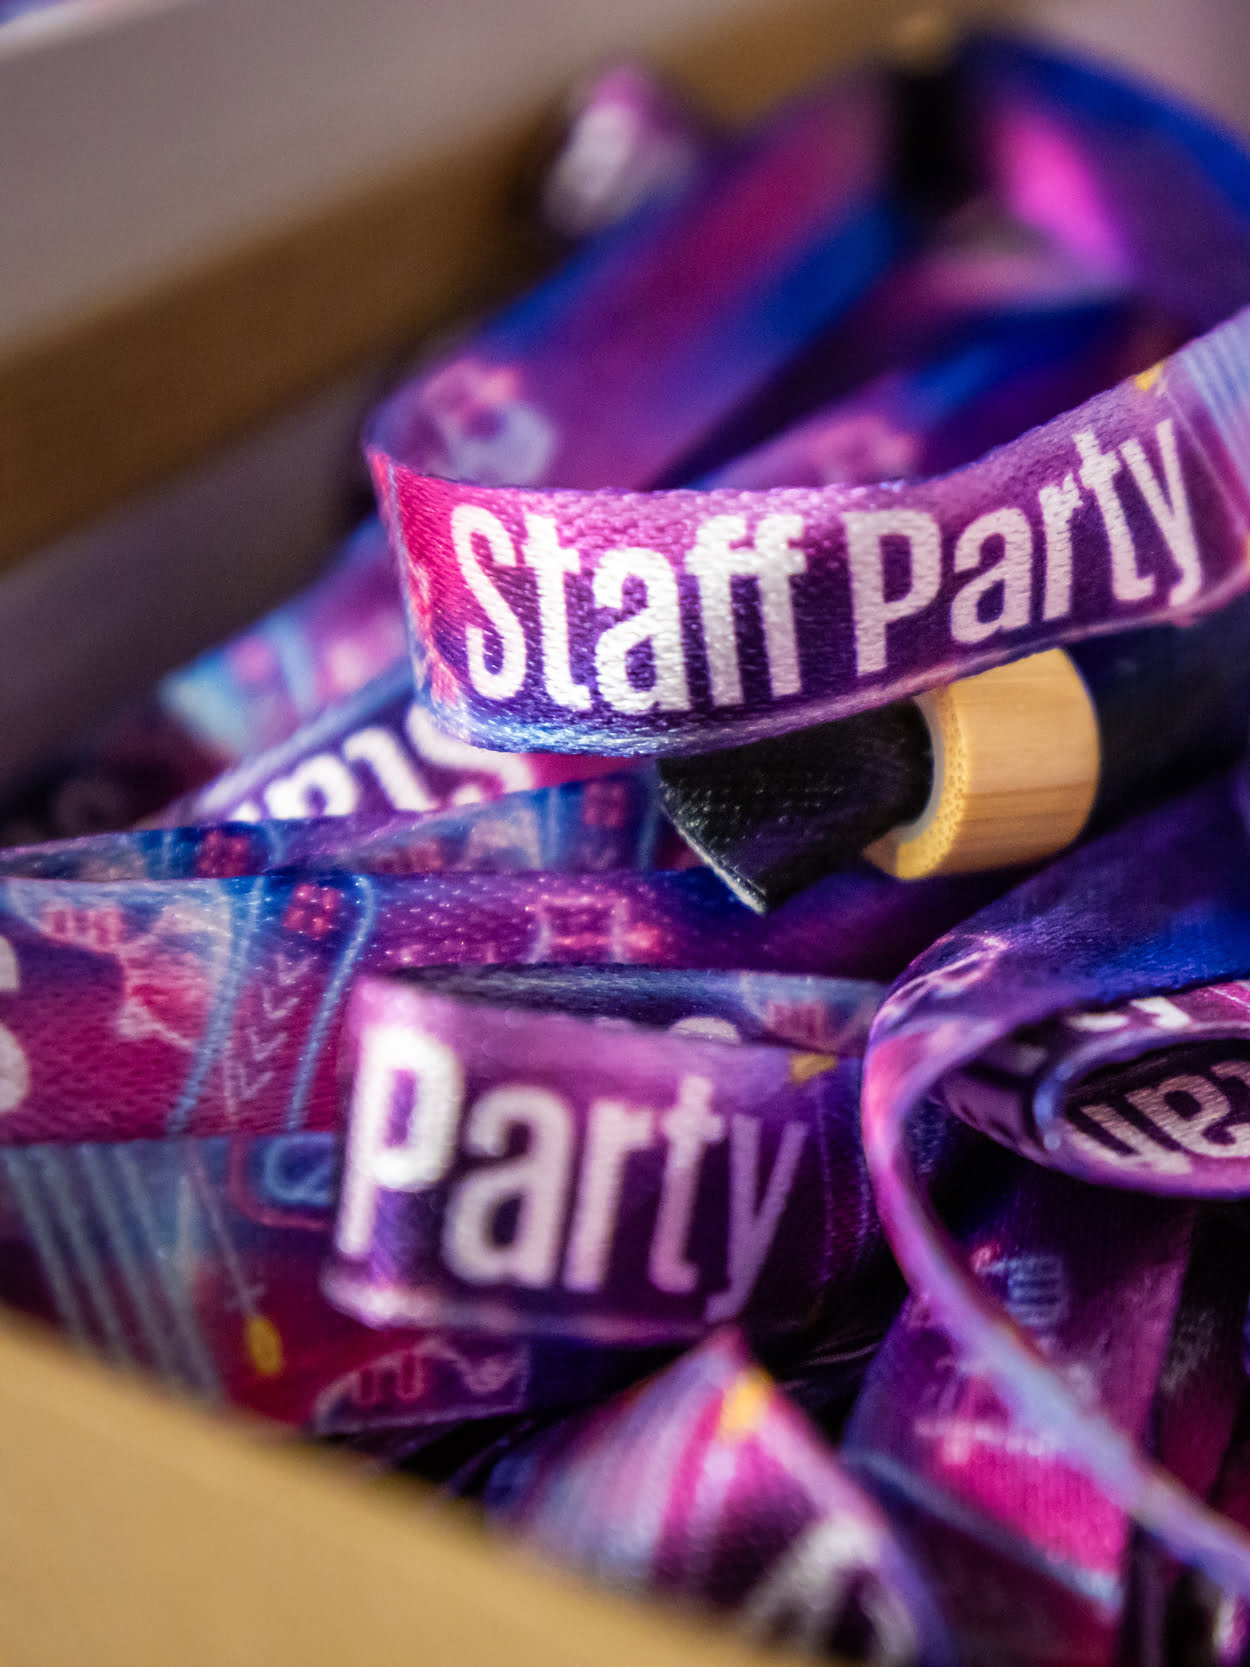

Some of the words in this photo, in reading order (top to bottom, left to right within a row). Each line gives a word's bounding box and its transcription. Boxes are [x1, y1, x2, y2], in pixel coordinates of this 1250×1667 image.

[450, 503, 807, 714] Staff
[842, 420, 1201, 676] Party
[334, 1020, 806, 1324] Party
